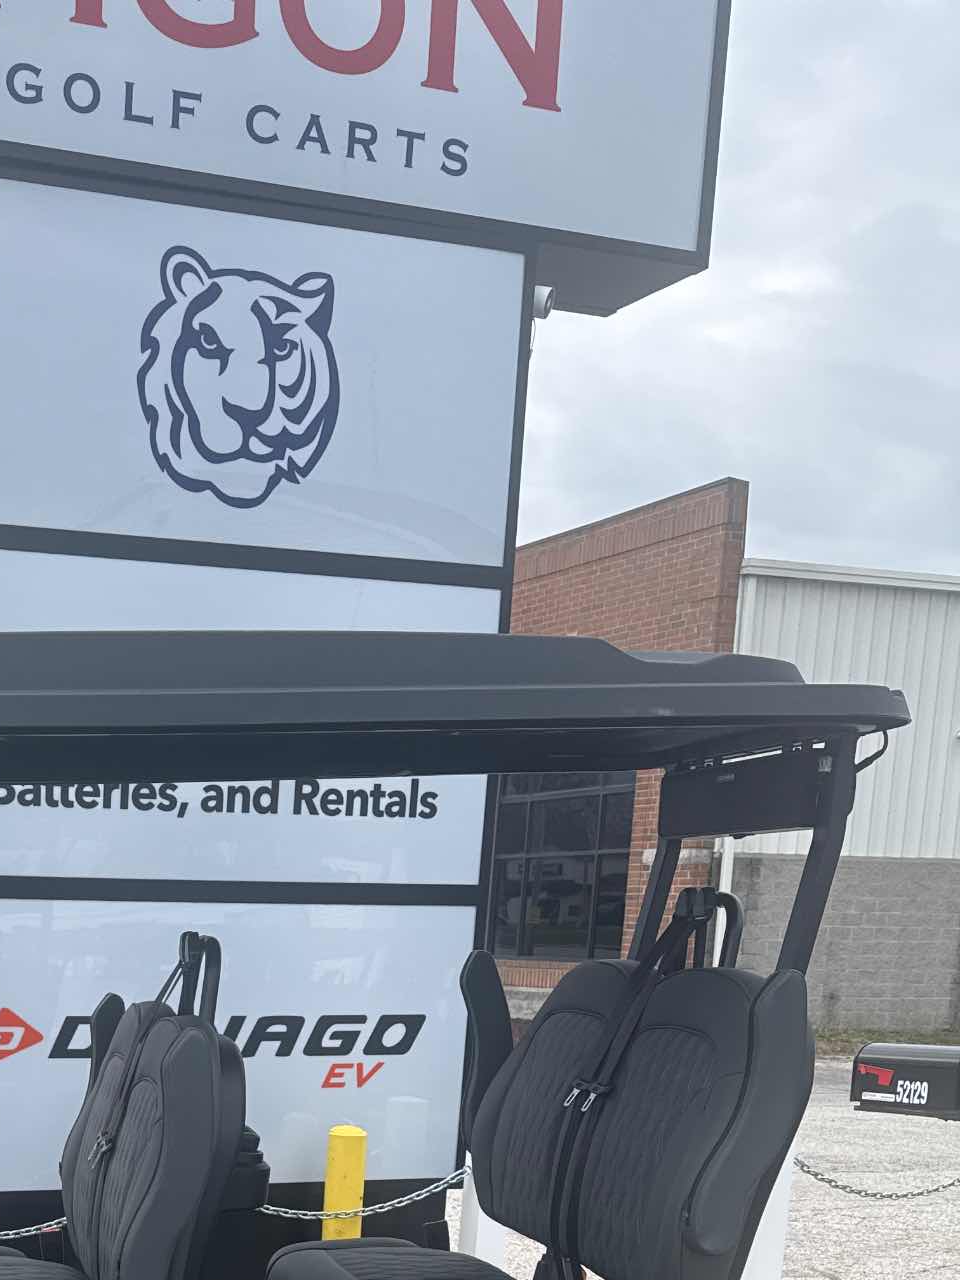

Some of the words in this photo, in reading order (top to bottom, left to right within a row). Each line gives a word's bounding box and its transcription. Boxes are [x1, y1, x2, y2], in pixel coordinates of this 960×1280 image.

[5, 62, 203, 130] GOLF
[245, 103, 471, 178] CARTS
[200, 779, 280, 814] and
[292, 778, 439, 820] Rentals
[321, 1061, 385, 1089] EV
[895, 1080, 929, 1105] 52129
